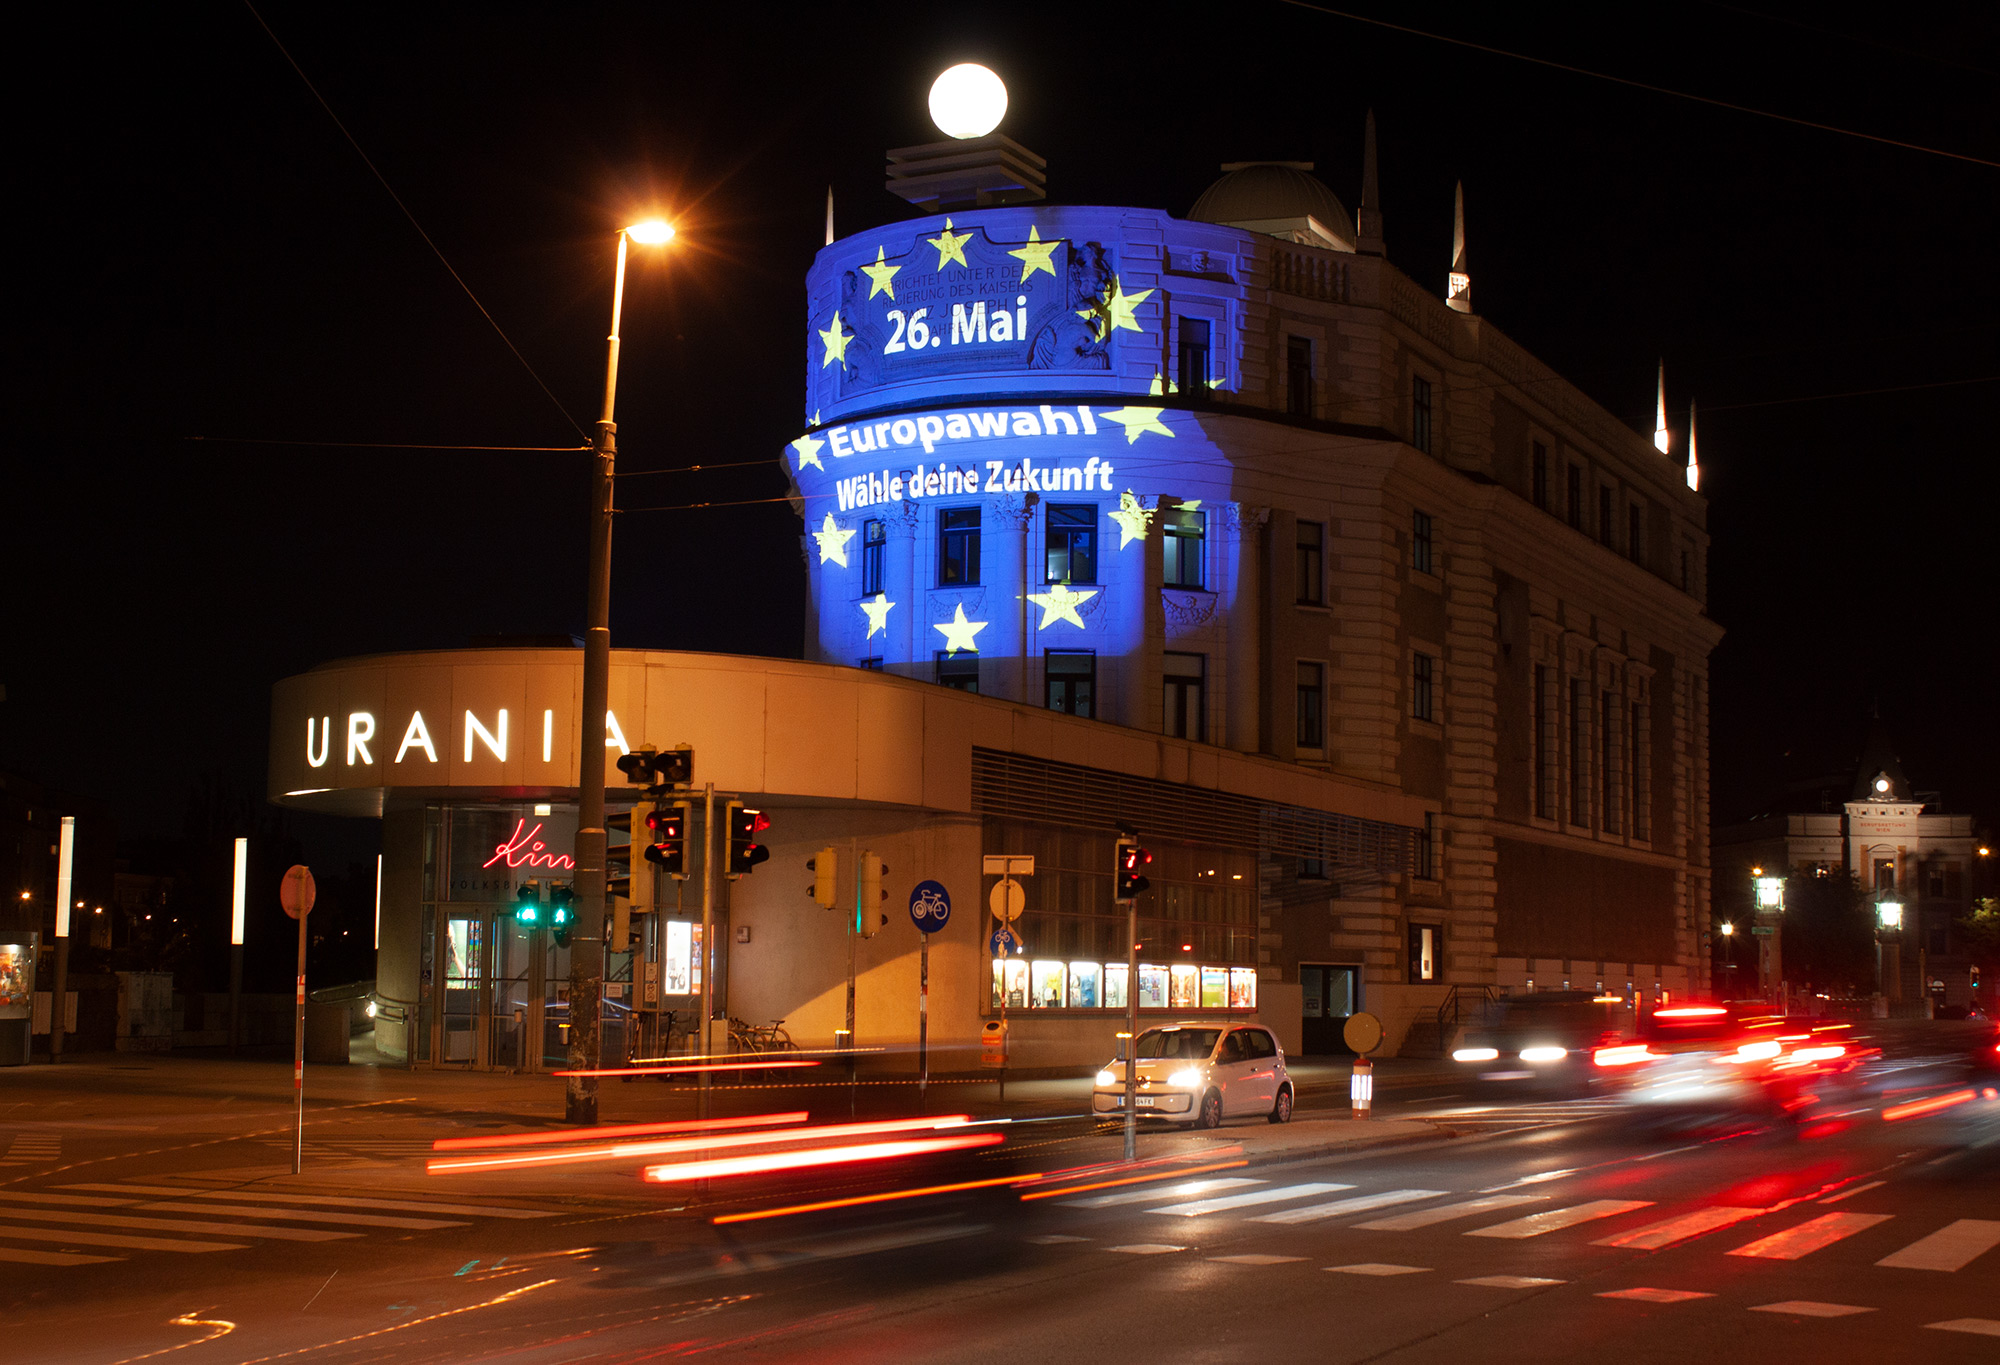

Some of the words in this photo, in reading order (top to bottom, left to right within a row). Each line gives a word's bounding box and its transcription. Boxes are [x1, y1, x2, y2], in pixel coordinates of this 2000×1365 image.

[883, 286, 945, 309] REGIERUNG
[950, 284, 974, 298] DES
[980, 279, 1033, 295] KAISERS
[948, 267, 995, 282] UNTER
[1001, 264, 1031, 279] DER
[883, 308, 941, 355] 26.
[951, 295, 1028, 345] Mai
[939, 298, 1008, 319] JOSEPH
[827, 404, 1098, 458] Europawahl
[836, 468, 903, 511] Wähle
[907, 463, 980, 498] deine
[984, 457, 1114, 493] Zukunft
